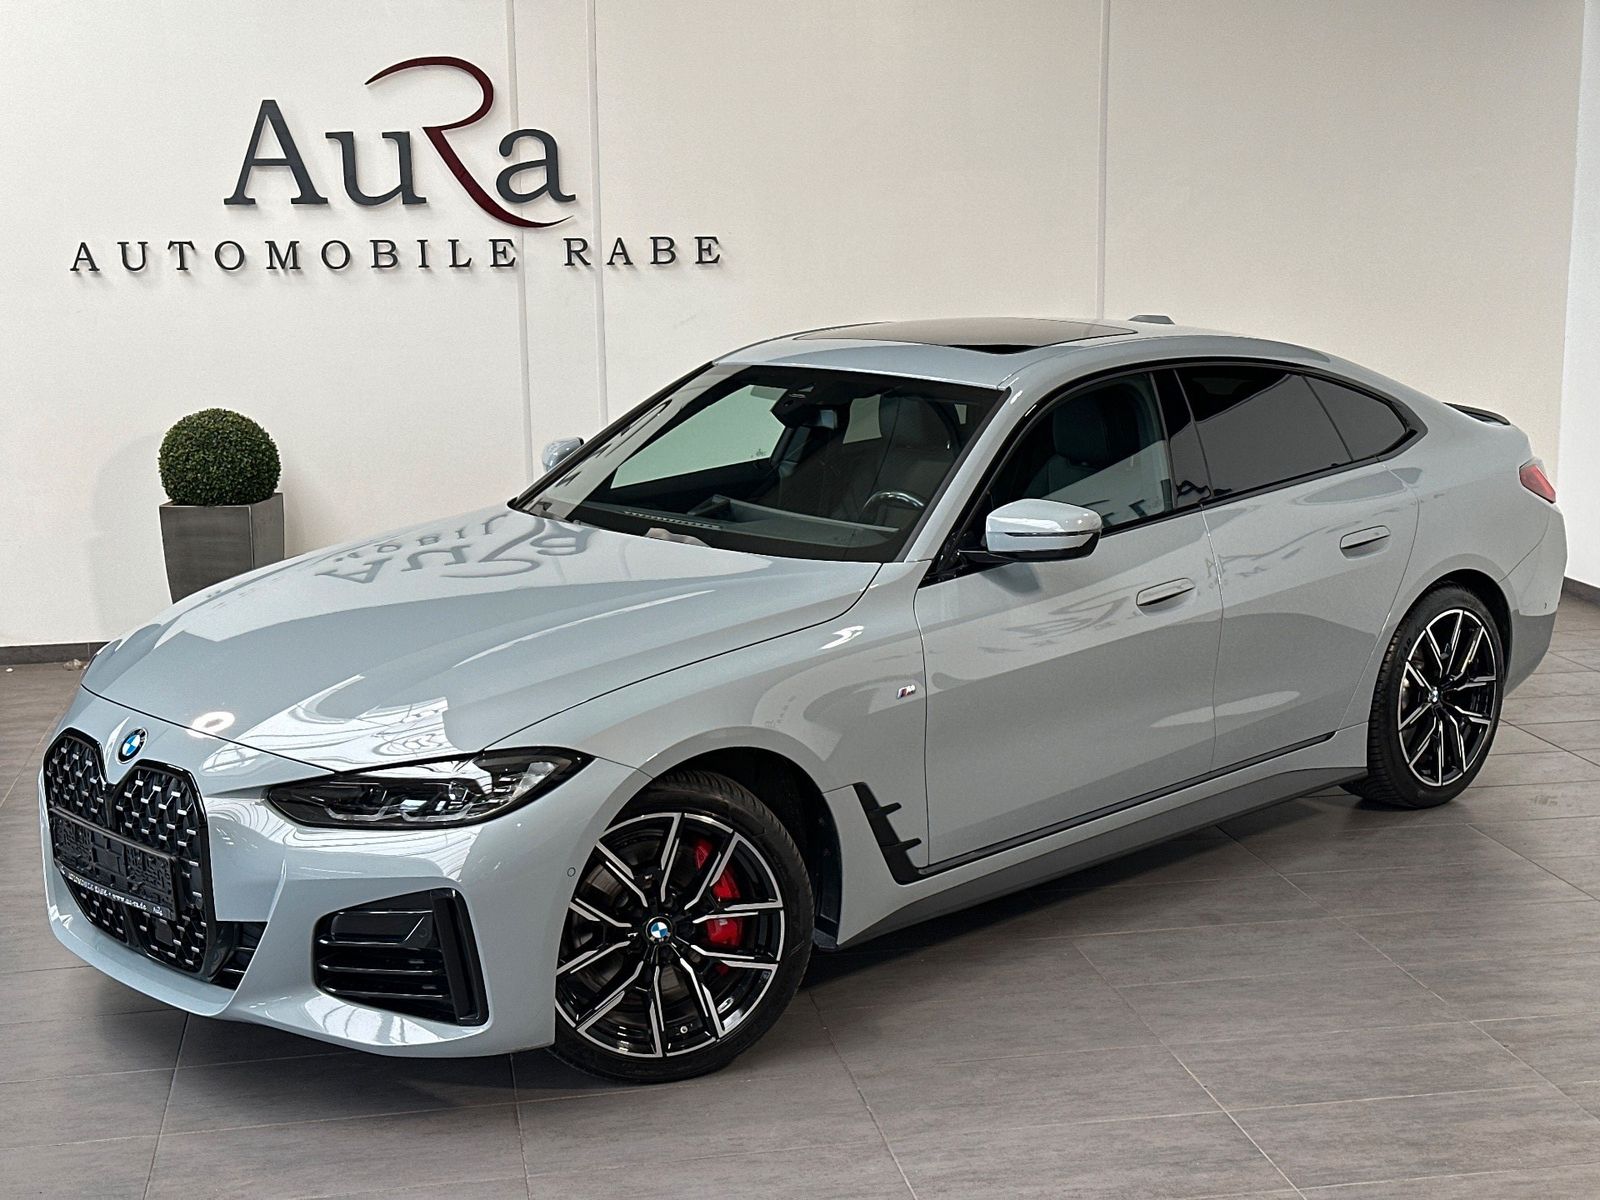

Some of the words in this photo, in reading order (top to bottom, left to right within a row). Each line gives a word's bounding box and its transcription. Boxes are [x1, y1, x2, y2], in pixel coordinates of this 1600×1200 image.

[224, 56, 577, 228] AuRa
[70, 238, 516, 273] AUTOMOBILE
[564, 236, 722, 267] RABE
